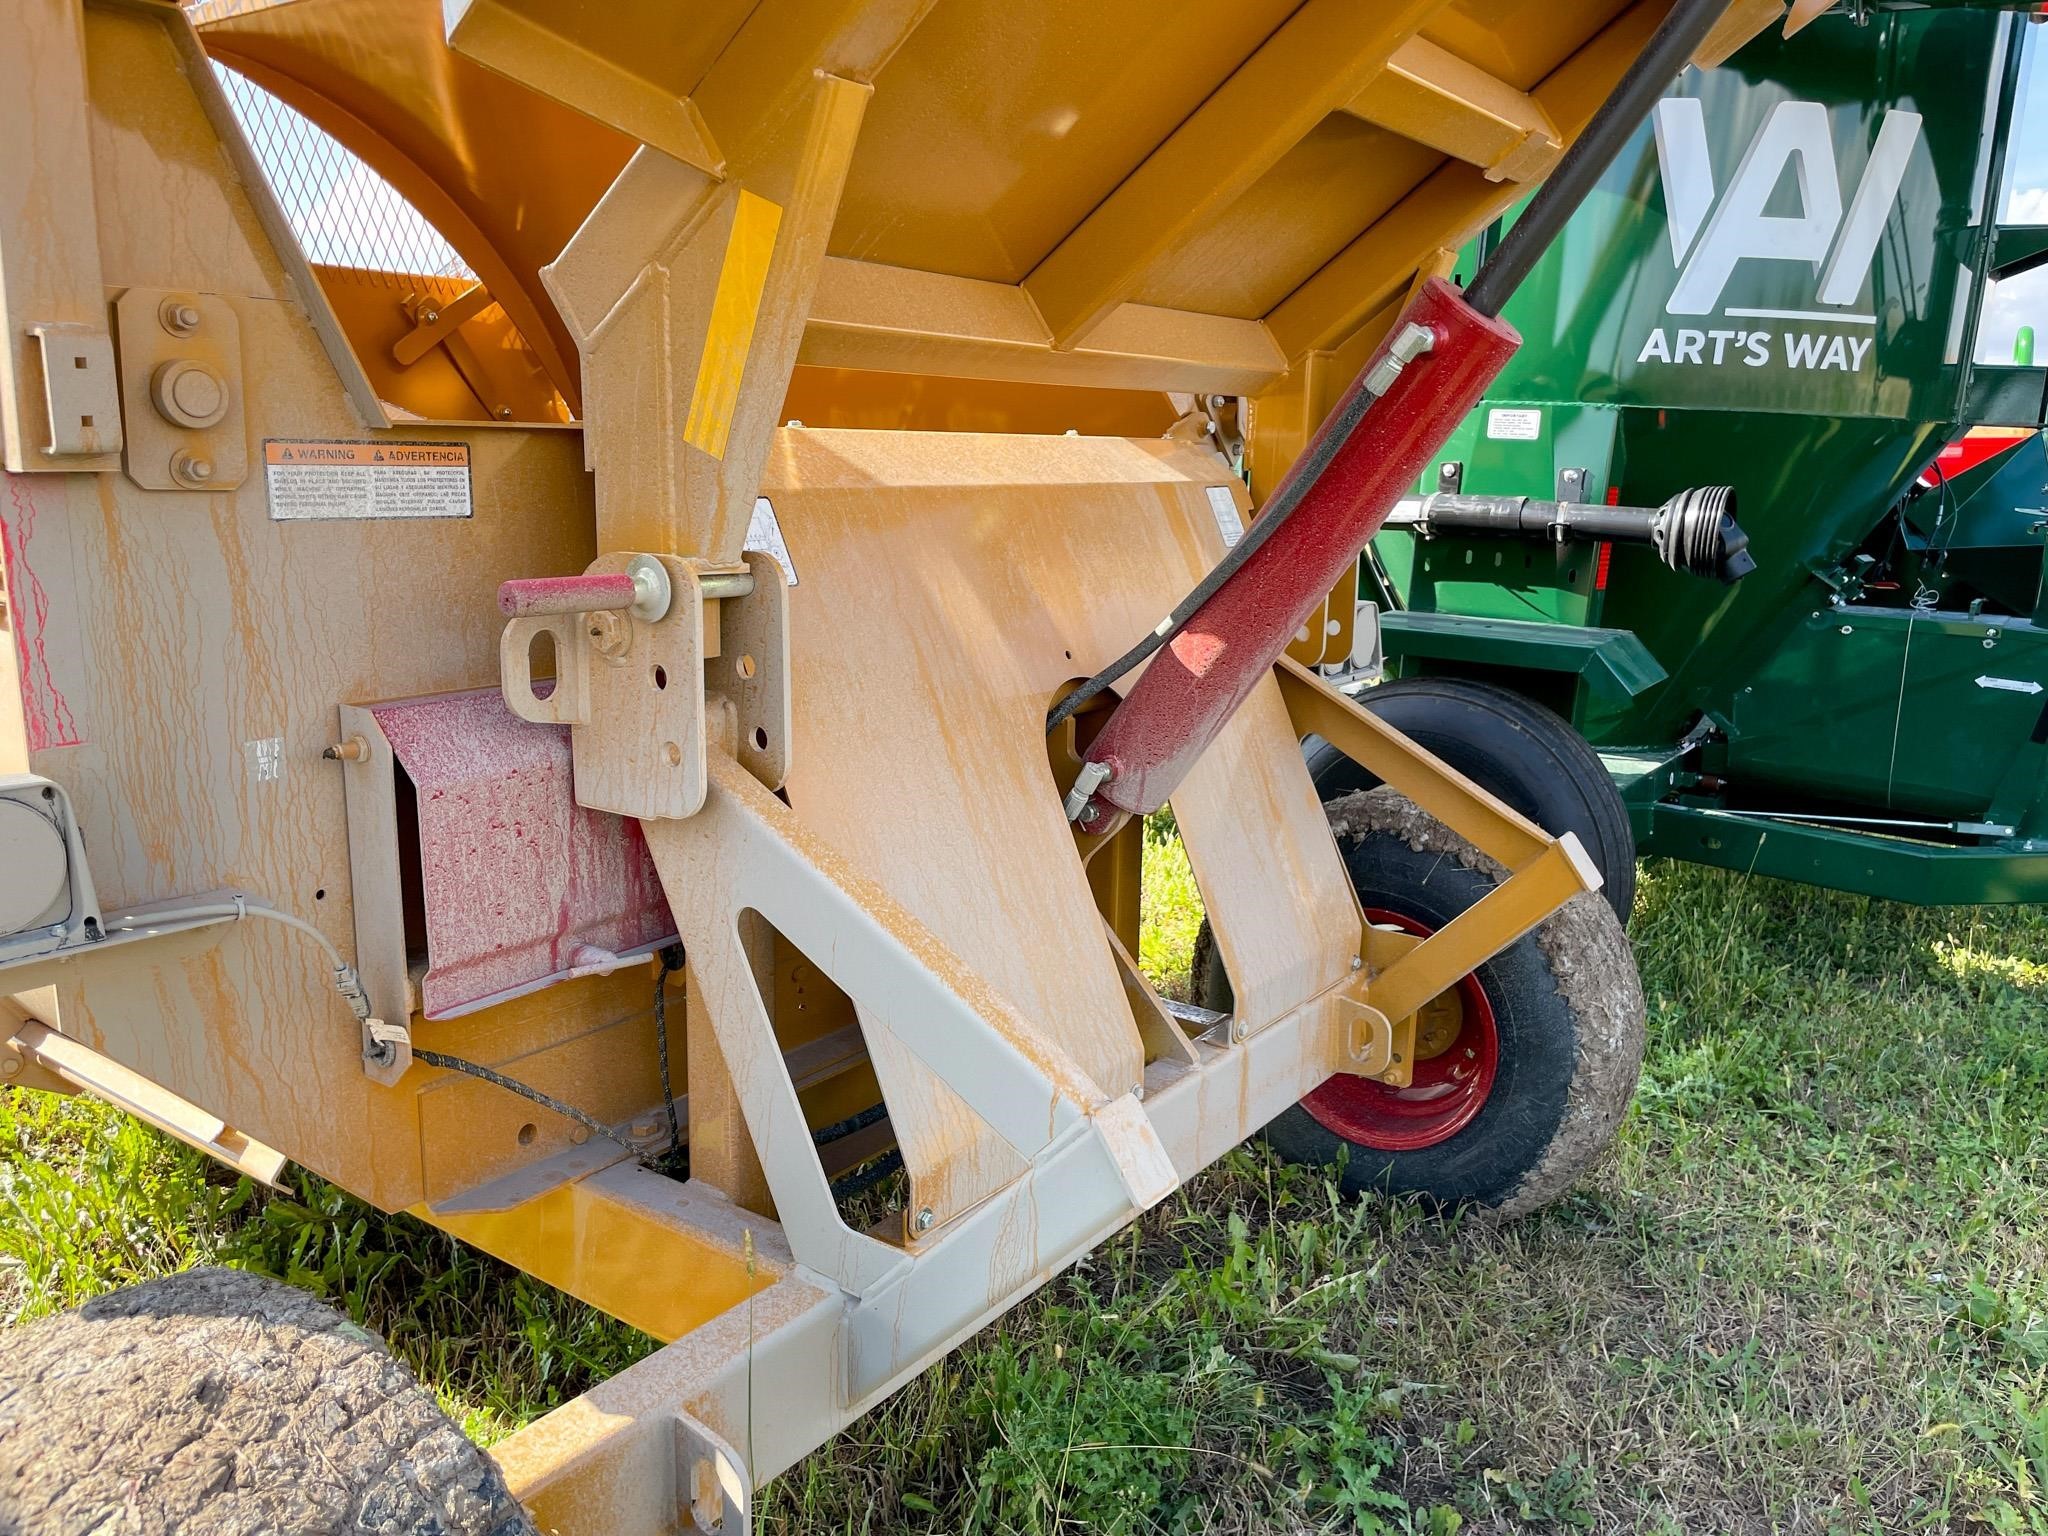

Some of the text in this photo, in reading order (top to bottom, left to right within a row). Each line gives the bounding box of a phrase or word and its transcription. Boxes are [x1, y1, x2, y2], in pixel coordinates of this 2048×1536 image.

[1636, 328, 1873, 371] ART'S WAY
[297, 448, 355, 460] WARNING
[389, 450, 464, 462] ADVERTENCIA
